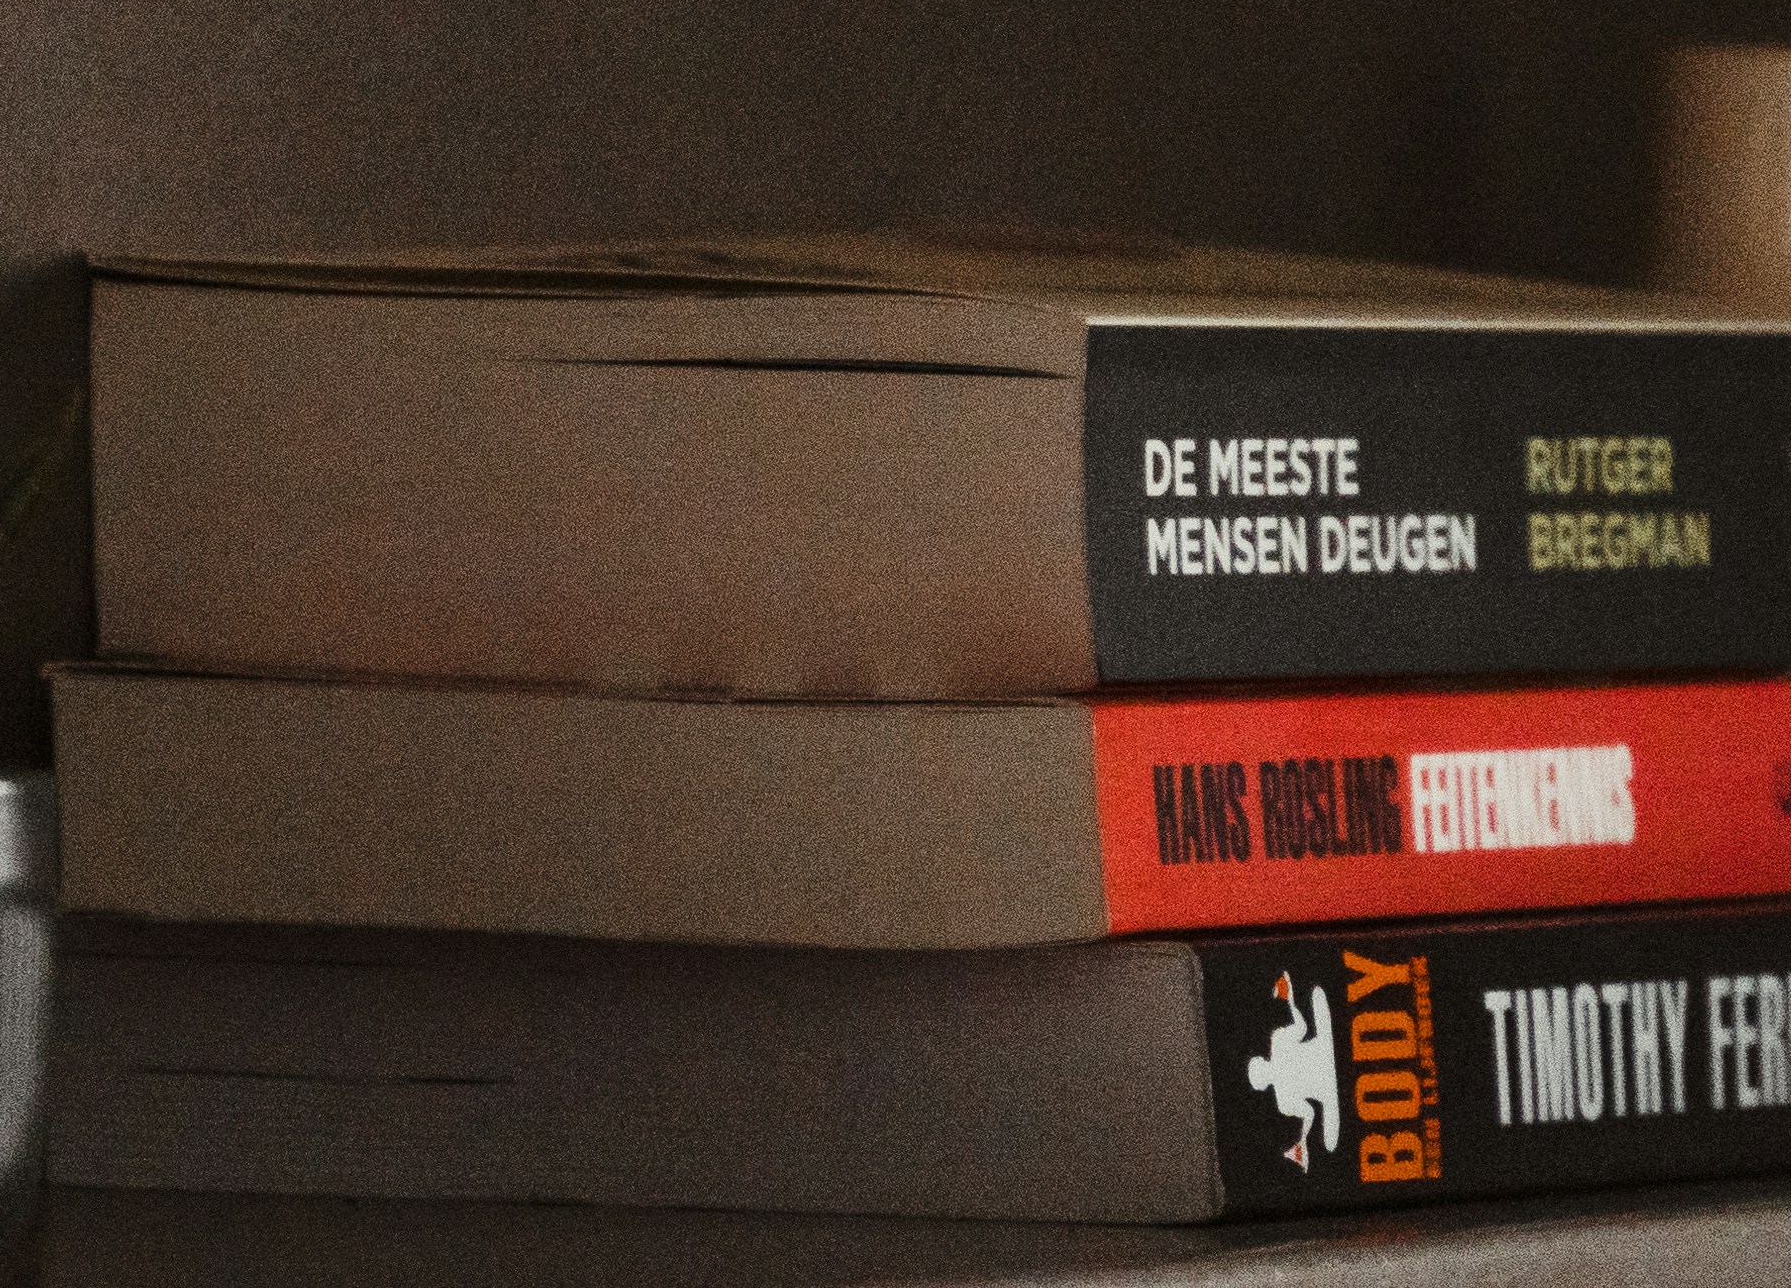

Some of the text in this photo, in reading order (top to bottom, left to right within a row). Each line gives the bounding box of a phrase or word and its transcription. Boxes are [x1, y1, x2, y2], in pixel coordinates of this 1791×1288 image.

[1143, 437, 1360, 498] DE MEESTE
[1525, 436, 1674, 495] RUTGER
[1145, 514, 1478, 577] MENSEN DEUGEN
[1528, 512, 1712, 571] BREGMAN
[1153, 762, 1251, 865] HANS
[1259, 755, 1404, 860] ROSLING
[1342, 950, 1424, 1183] BODY
[1484, 979, 1689, 1126] TIMOTHY
